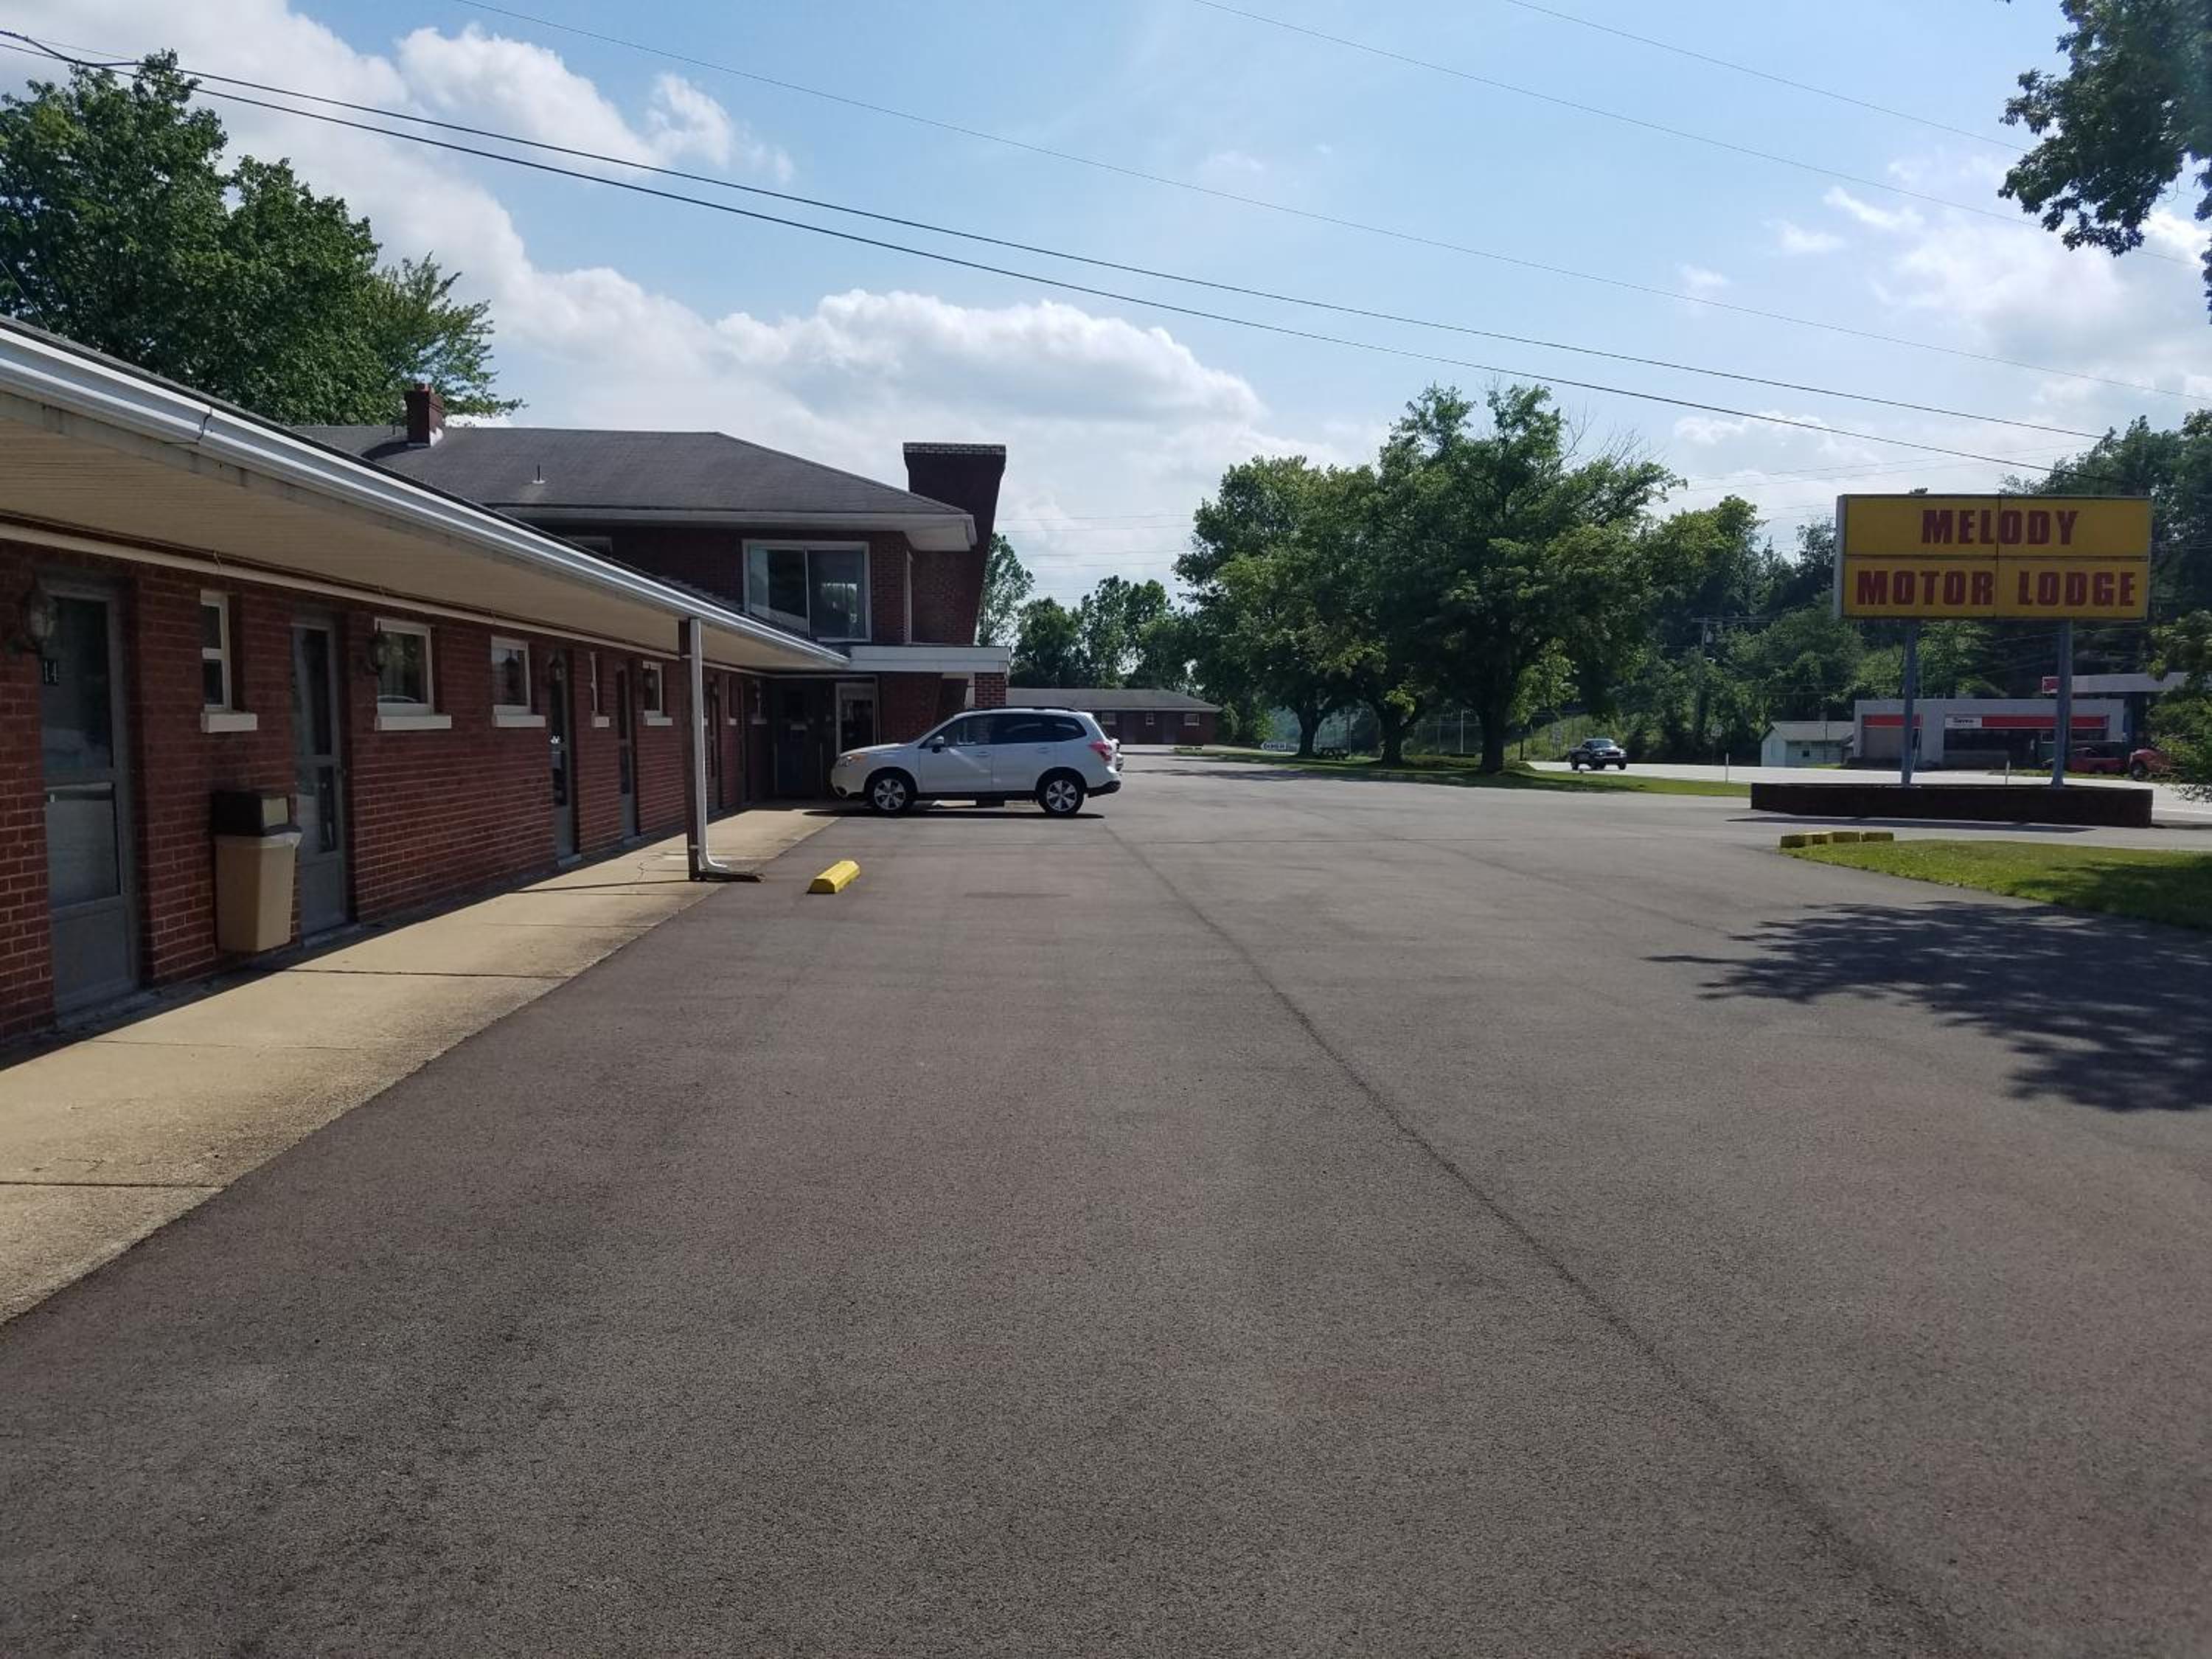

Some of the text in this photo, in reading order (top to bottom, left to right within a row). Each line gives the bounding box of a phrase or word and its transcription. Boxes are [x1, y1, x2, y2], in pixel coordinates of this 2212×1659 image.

[1922, 510, 2079, 544] MELODY
[1857, 571, 2135, 606] MOTOR LODGE
